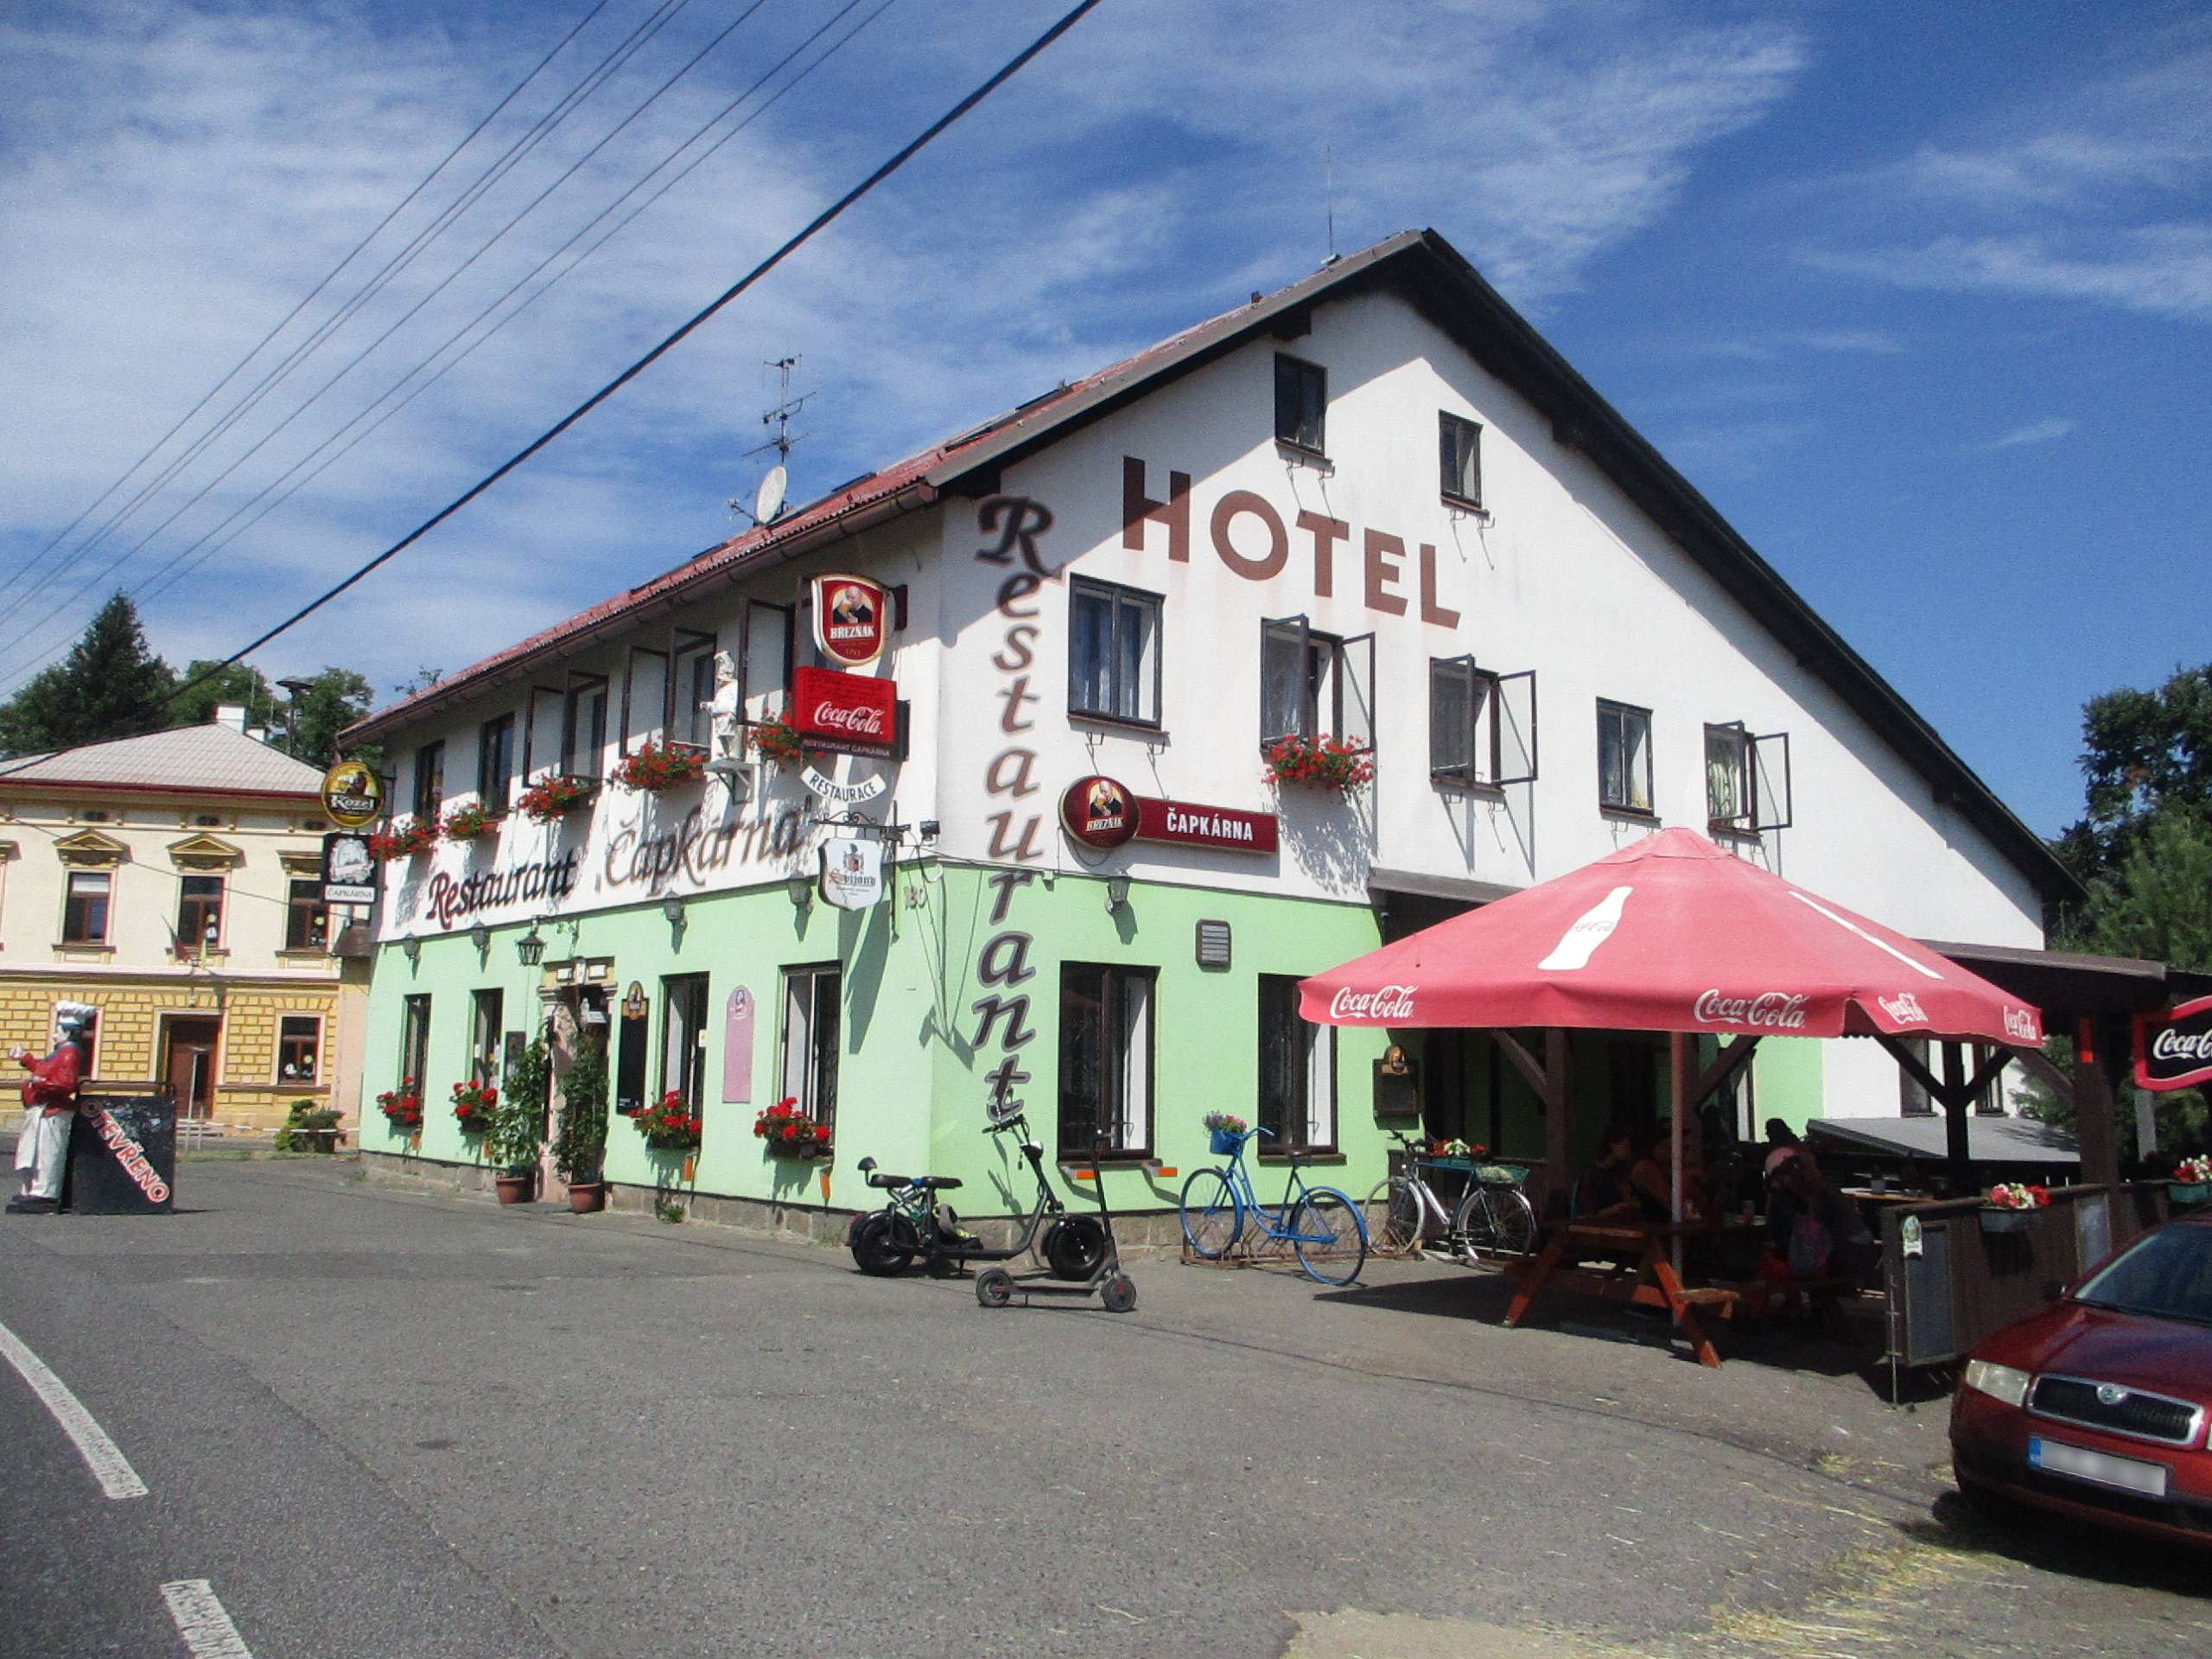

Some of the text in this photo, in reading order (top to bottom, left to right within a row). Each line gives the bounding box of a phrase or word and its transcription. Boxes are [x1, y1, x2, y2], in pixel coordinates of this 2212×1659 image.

[1123, 455, 1460, 629] HOTEL
[814, 700, 884, 734] Coca-Cola
[332, 795, 374, 810] Kozel
[810, 773, 877, 803] RESTAURACE
[971, 493, 1066, 1123] Restaurant
[1166, 807, 1253, 842] ČAPKÁRNA
[425, 848, 577, 931] Restaurant
[1330, 985, 1418, 1020] Coca-Cola
[1694, 988, 1810, 1028] Coca-Cola
[81, 1099, 170, 1203] OTEVŘENO
